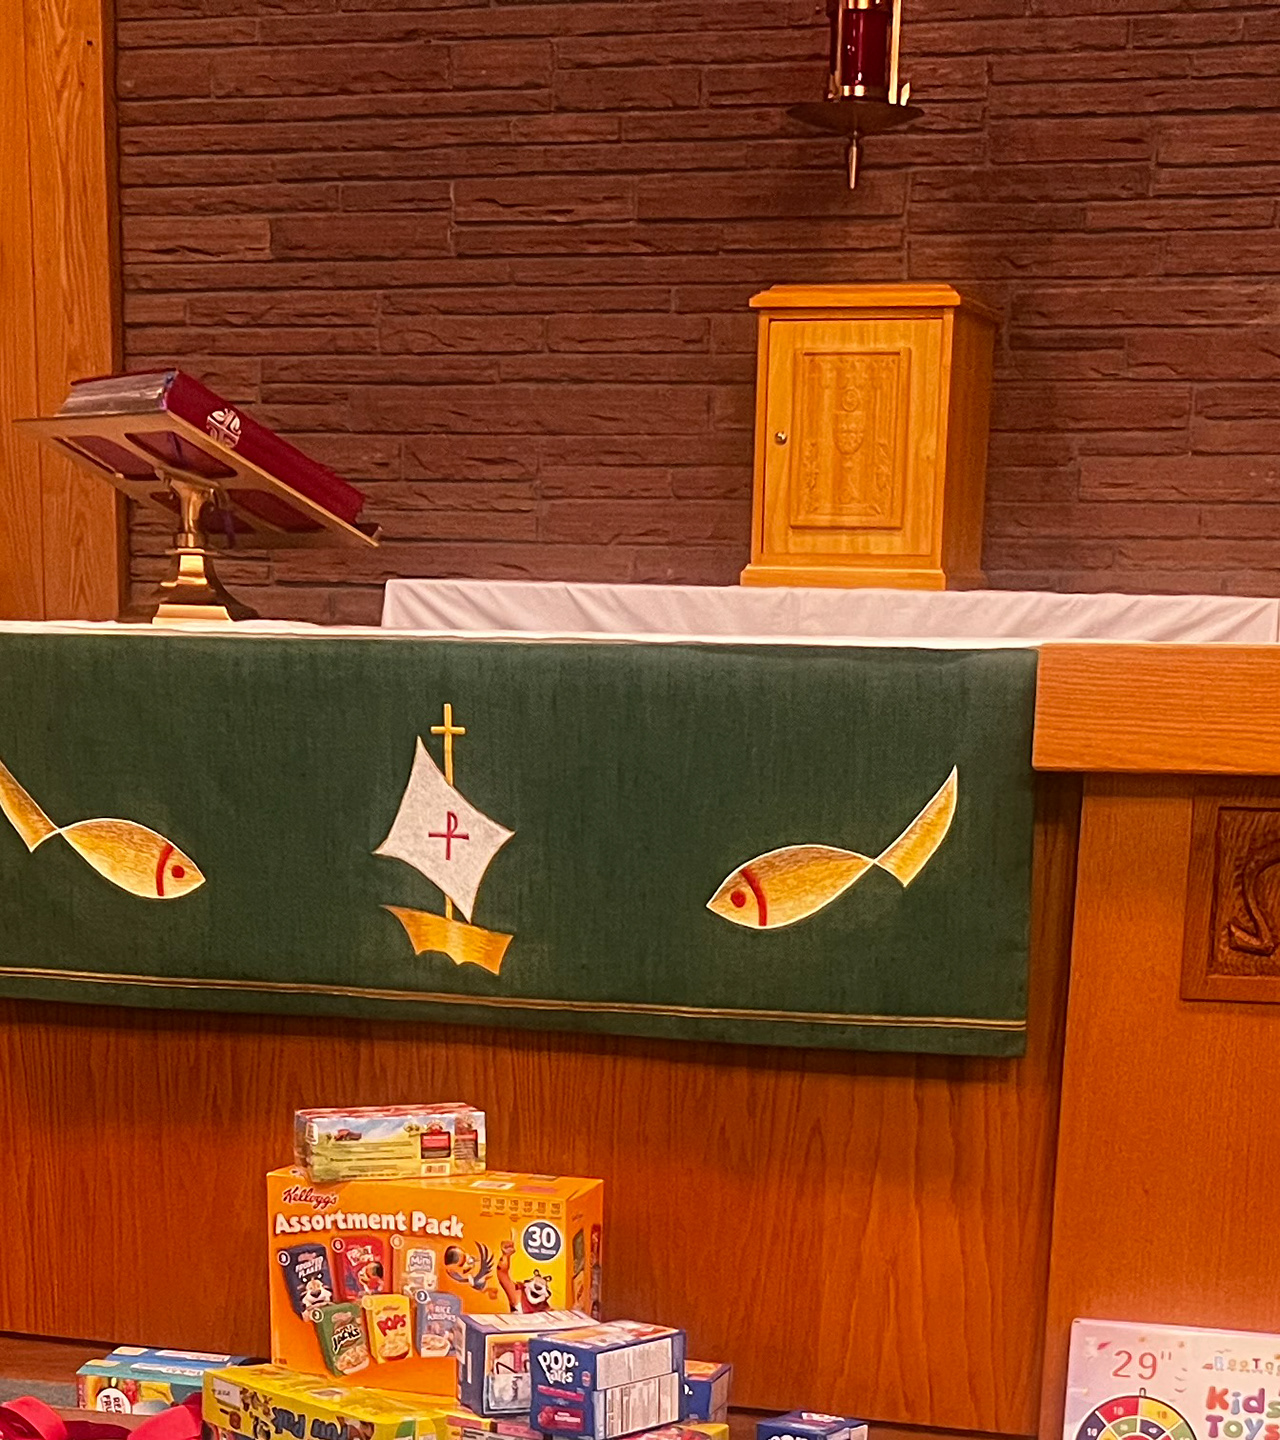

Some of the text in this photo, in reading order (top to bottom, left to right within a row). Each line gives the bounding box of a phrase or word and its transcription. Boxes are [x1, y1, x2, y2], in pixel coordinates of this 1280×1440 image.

[282, 1186, 338, 1210] Kellogg's
[275, 1210, 465, 1238] Assortment Pack
[527, 1226, 557, 1248] 30
[376, 1314, 407, 1336] POPS
